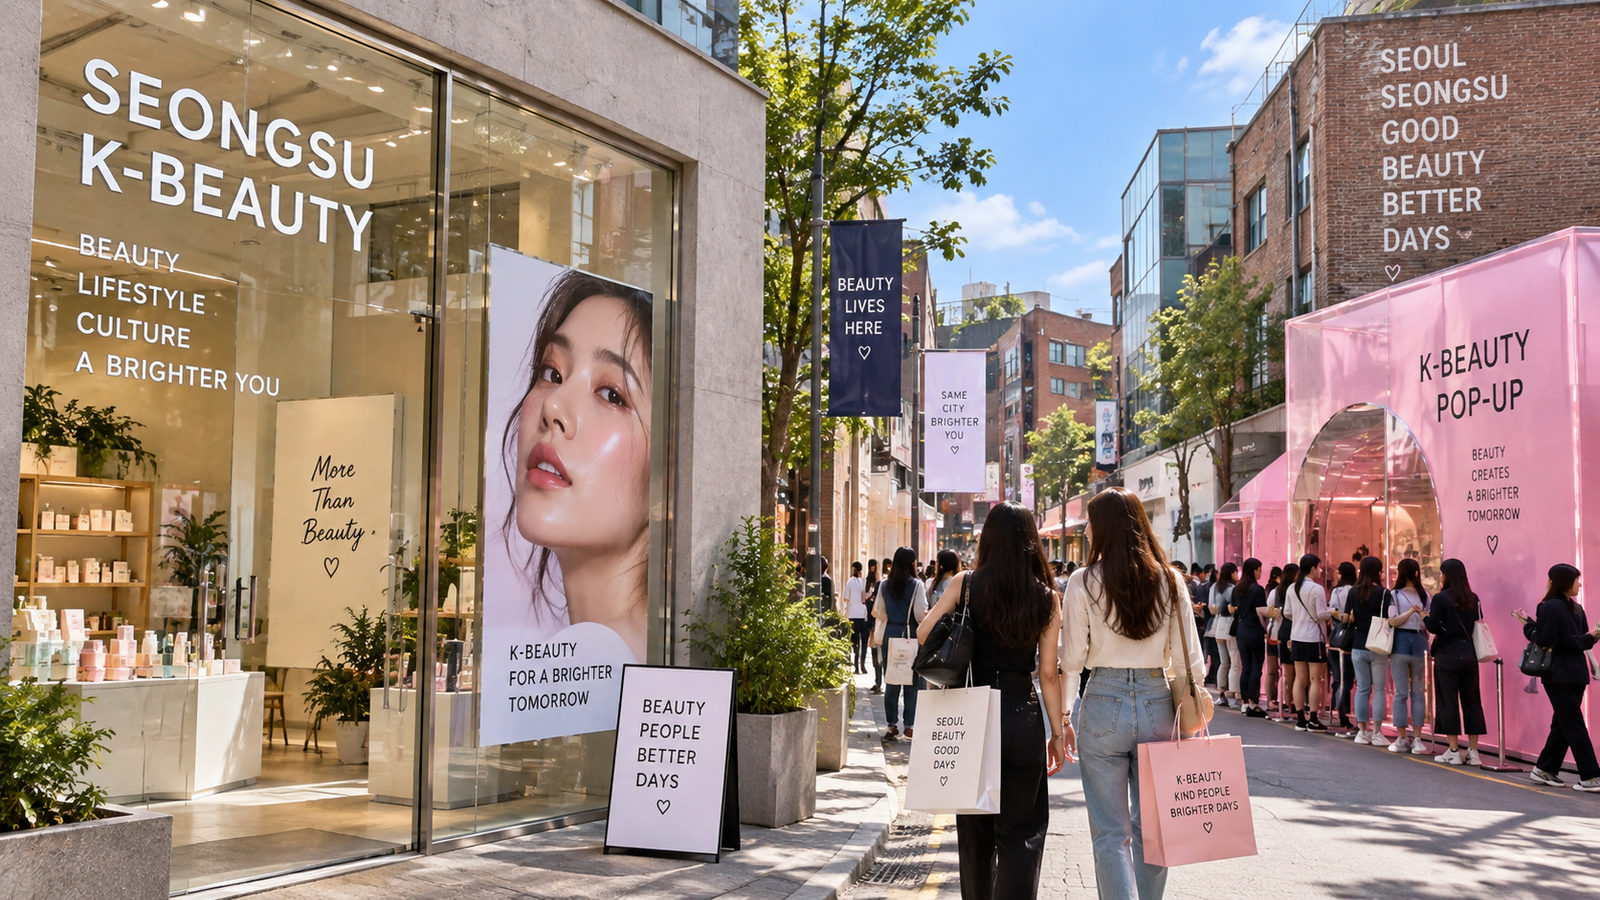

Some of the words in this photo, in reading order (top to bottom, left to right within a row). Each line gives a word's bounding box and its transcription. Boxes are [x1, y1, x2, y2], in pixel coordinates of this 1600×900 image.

[1380, 44, 1467, 74] SEOUL
[1380, 73, 1508, 109] SEONGSU
[81, 58, 375, 190] SEONGSU
[1381, 115, 1459, 145] GOOD
[1382, 149, 1486, 181] BEAUTY
[80, 132, 373, 252] K-BEAUTY
[1382, 186, 1482, 216] BETTER
[1383, 225, 1450, 253] DAYS
[78, 233, 180, 272] BEAUTY
[77, 271, 206, 315] LIFESTYLE
[837, 276, 894, 292] BEAUTY
[845, 298, 885, 314] LIVES
[76, 311, 191, 349] CULTURE
[845, 320, 883, 335] HERE
[1419, 329, 1530, 383] K-BEAUTY
[74, 351, 94, 374] A
[107, 354, 228, 391] BRIGHTER
[235, 372, 280, 397] YOU
[941, 390, 967, 400] SAME
[1437, 378, 1524, 423] POP-UP
[942, 403, 965, 413] CITY
[931, 417, 979, 427] BRIGHTER
[944, 430, 964, 440] YOU
[1472, 445, 1506, 461] BEAUTY
[310, 454, 356, 482] More
[1471, 465, 1510, 482] CREATES
[312, 486, 355, 512] Than
[1466, 490, 1475, 502] A
[1475, 486, 1519, 502] BRIGHTER
[1467, 507, 1521, 522] TOMORROW
[302, 517, 365, 552] Beauty
[510, 642, 577, 661] K-BEAUTY
[509, 669, 536, 687] FOR
[539, 668, 549, 684] A
[552, 664, 613, 683] BRIGHTER
[508, 690, 590, 713] TOMORROW
[642, 698, 706, 716] BEAUTY
[936, 716, 964, 727] SEOUL
[639, 722, 701, 740] PEOPLE
[931, 730, 966, 741] BEAUTY
[637, 747, 697, 765] BETTER
[933, 745, 960, 755] GOOD
[933, 759, 956, 770] DAYS
[635, 772, 679, 789] DAYS
[1176, 770, 1222, 785] K-BEAUTY
[1174, 790, 1196, 802] KIND
[1197, 785, 1231, 799] PEOPLE
[1170, 803, 1215, 818] BRIGHTER
[1216, 800, 1239, 813] DAYS
